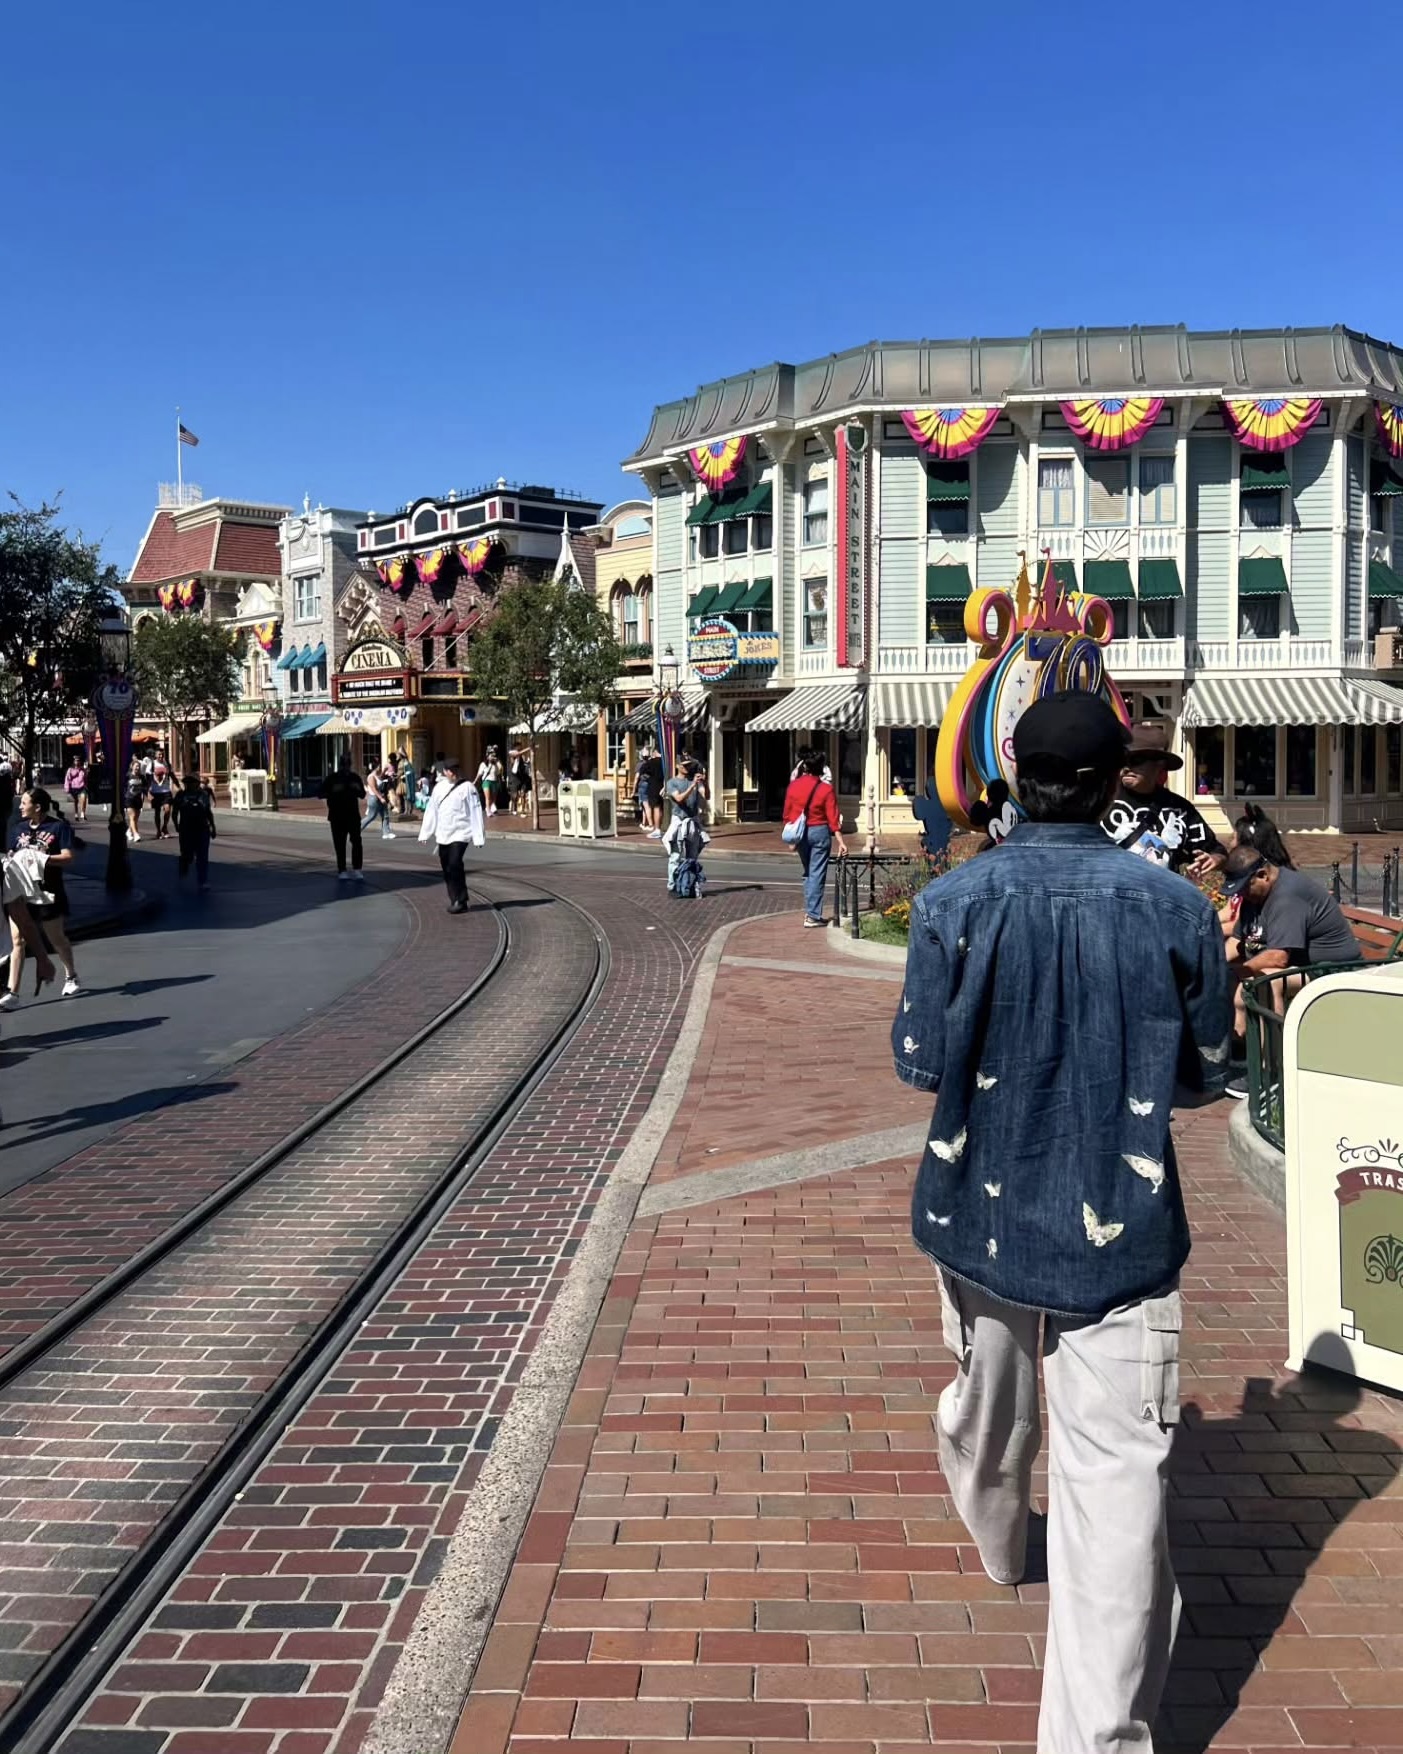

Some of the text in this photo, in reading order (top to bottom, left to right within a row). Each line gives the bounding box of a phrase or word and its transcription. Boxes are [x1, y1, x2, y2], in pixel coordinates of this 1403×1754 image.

[850, 461, 860, 520] MAIN
[850, 536, 860, 625] STREET
[351, 652, 392, 669] CINEMA
[744, 642, 772, 654] JOKES
